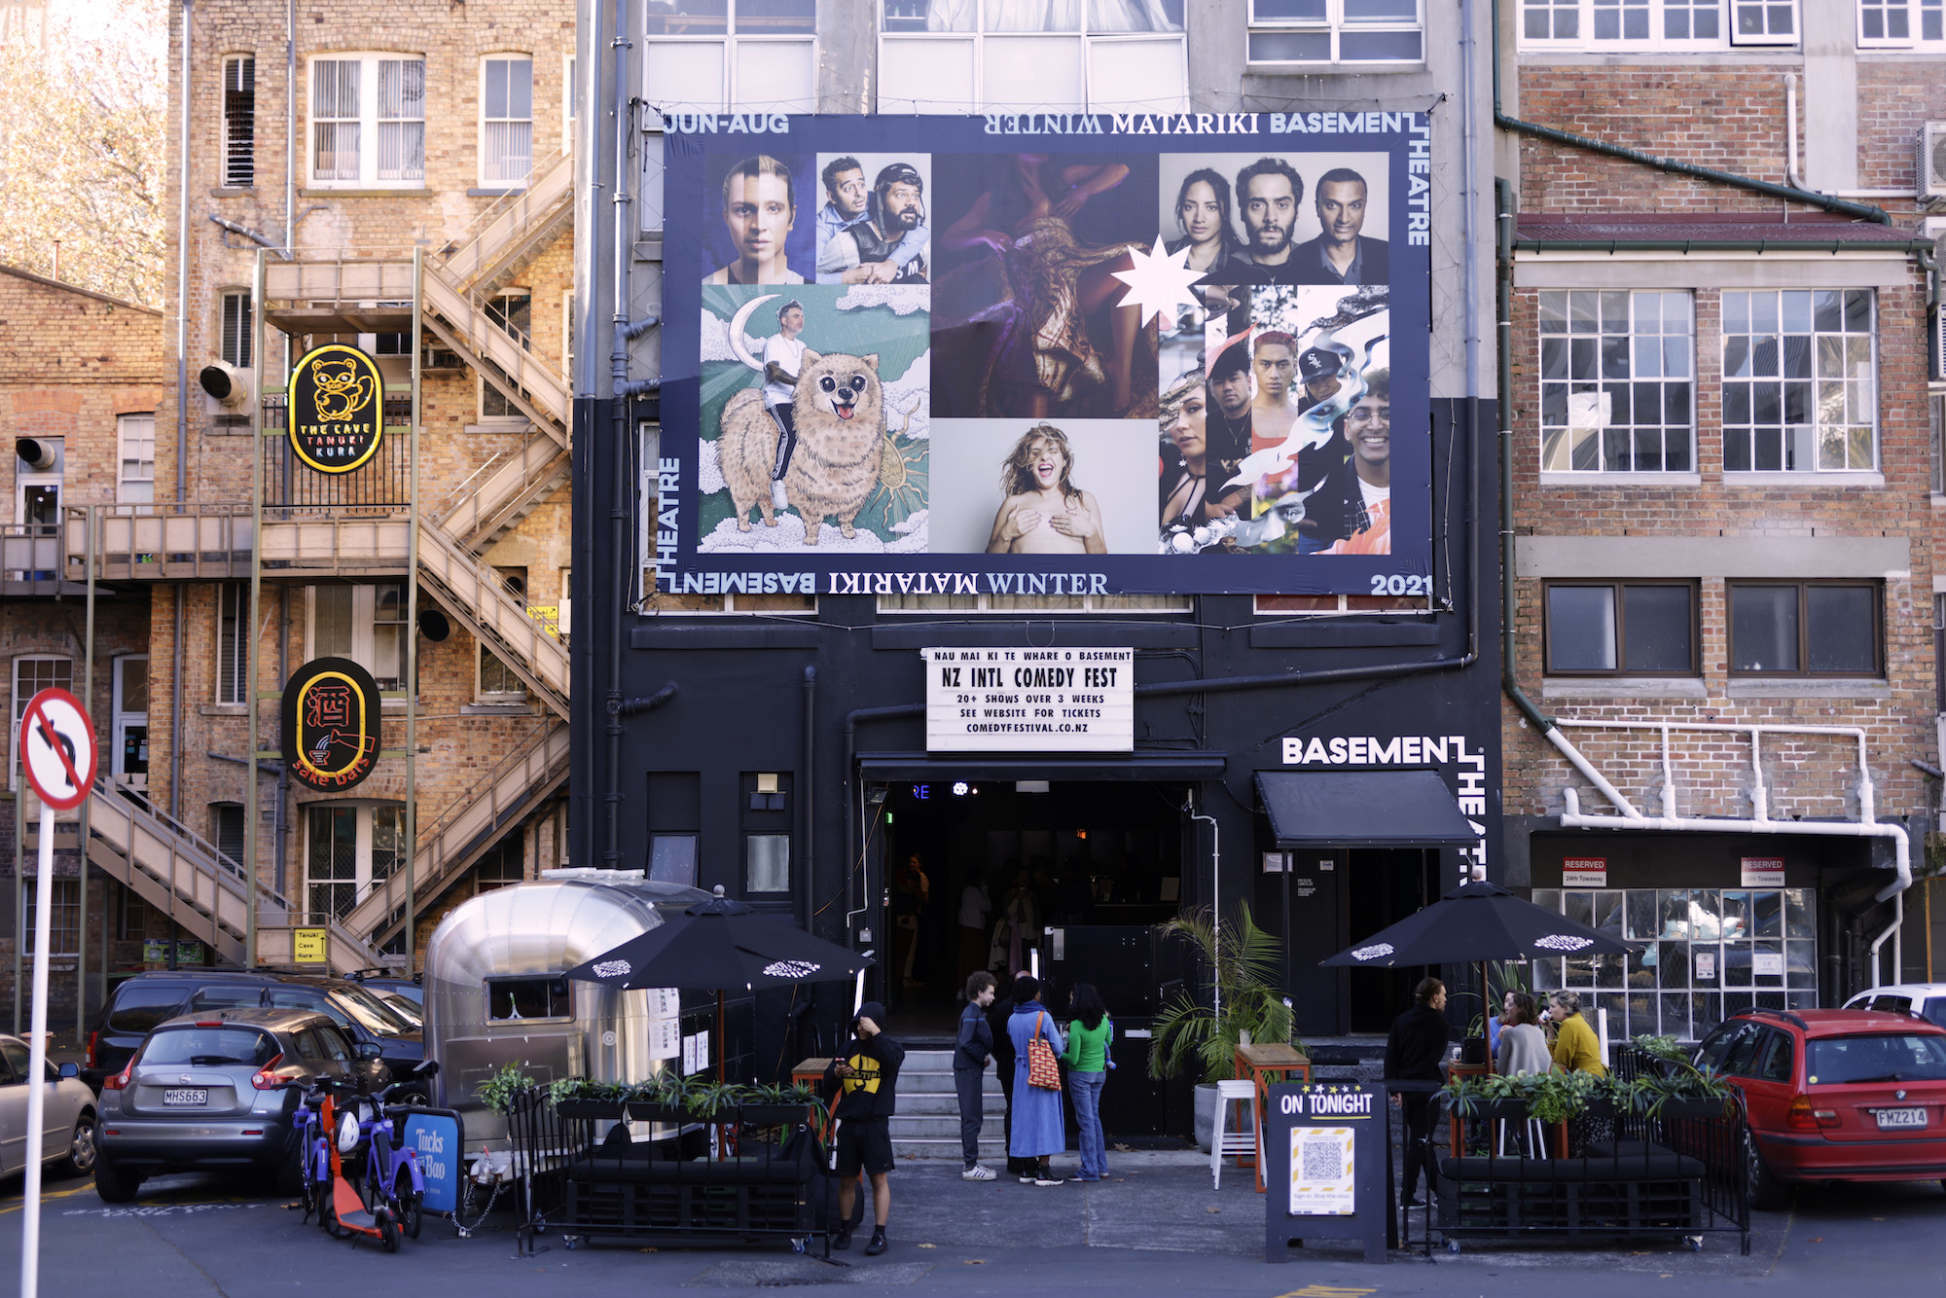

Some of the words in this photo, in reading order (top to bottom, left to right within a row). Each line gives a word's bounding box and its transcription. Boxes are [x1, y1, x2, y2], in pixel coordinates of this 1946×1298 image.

[664, 114, 789, 134] JUN-AUG
[984, 114, 1100, 135] WINTER
[1111, 113, 1259, 134] MATARIKI
[1270, 112, 1416, 133] BASEMENT
[1407, 126, 1430, 246] THEATRE
[301, 425, 328, 435] THE
[334, 423, 370, 434] CAVE
[307, 435, 364, 446] TANUKI
[316, 446, 355, 457] KURA
[656, 458, 680, 578] THEATRE
[669, 572, 816, 594] BASEMENT
[828, 572, 979, 594] MATARIKI
[985, 573, 1109, 594] WINTER
[1370, 574, 1434, 596] 2021
[934, 652, 955, 660] NAU
[961, 652, 980, 660] MAI
[987, 652, 998, 660] KI
[1005, 652, 1015, 660] TE
[1023, 652, 1058, 660] WHARE
[1079, 652, 1131, 660] BASEMENT
[942, 667, 961, 687] NZ
[971, 667, 1003, 687] INTL
[1014, 667, 1074, 687] COMEDY
[1085, 667, 1117, 687] FEST
[307, 686, 351, 728] 酒
[957, 695, 976, 703] 20+
[985, 695, 1019, 703] SHOWS
[1026, 695, 1051, 703] OVER
[1058, 695, 1064, 703] 3
[1072, 695, 1105, 703] WEEKS
[960, 709, 977, 717] SEE
[984, 709, 1026, 717] WEBSITE
[1035, 709, 1054, 717] FOR
[1062, 709, 1101, 717] TICKETS
[966, 723, 1088, 732] COMEDYFESTIVAL.CO.NZ
[1282, 736, 1465, 764] BASEMENT
[292, 760, 329, 786] sake
[335, 757, 370, 785] bars
[1565, 860, 1605, 868] RESERVED
[166, 1090, 207, 1101] MHS663
[1281, 1095, 1303, 1114] ON
[1309, 1094, 1373, 1113] TONIGHT
[1879, 1111, 1925, 1123] FMZ214
[416, 1128, 443, 1153] Tucks
[426, 1155, 446, 1179] Bao
